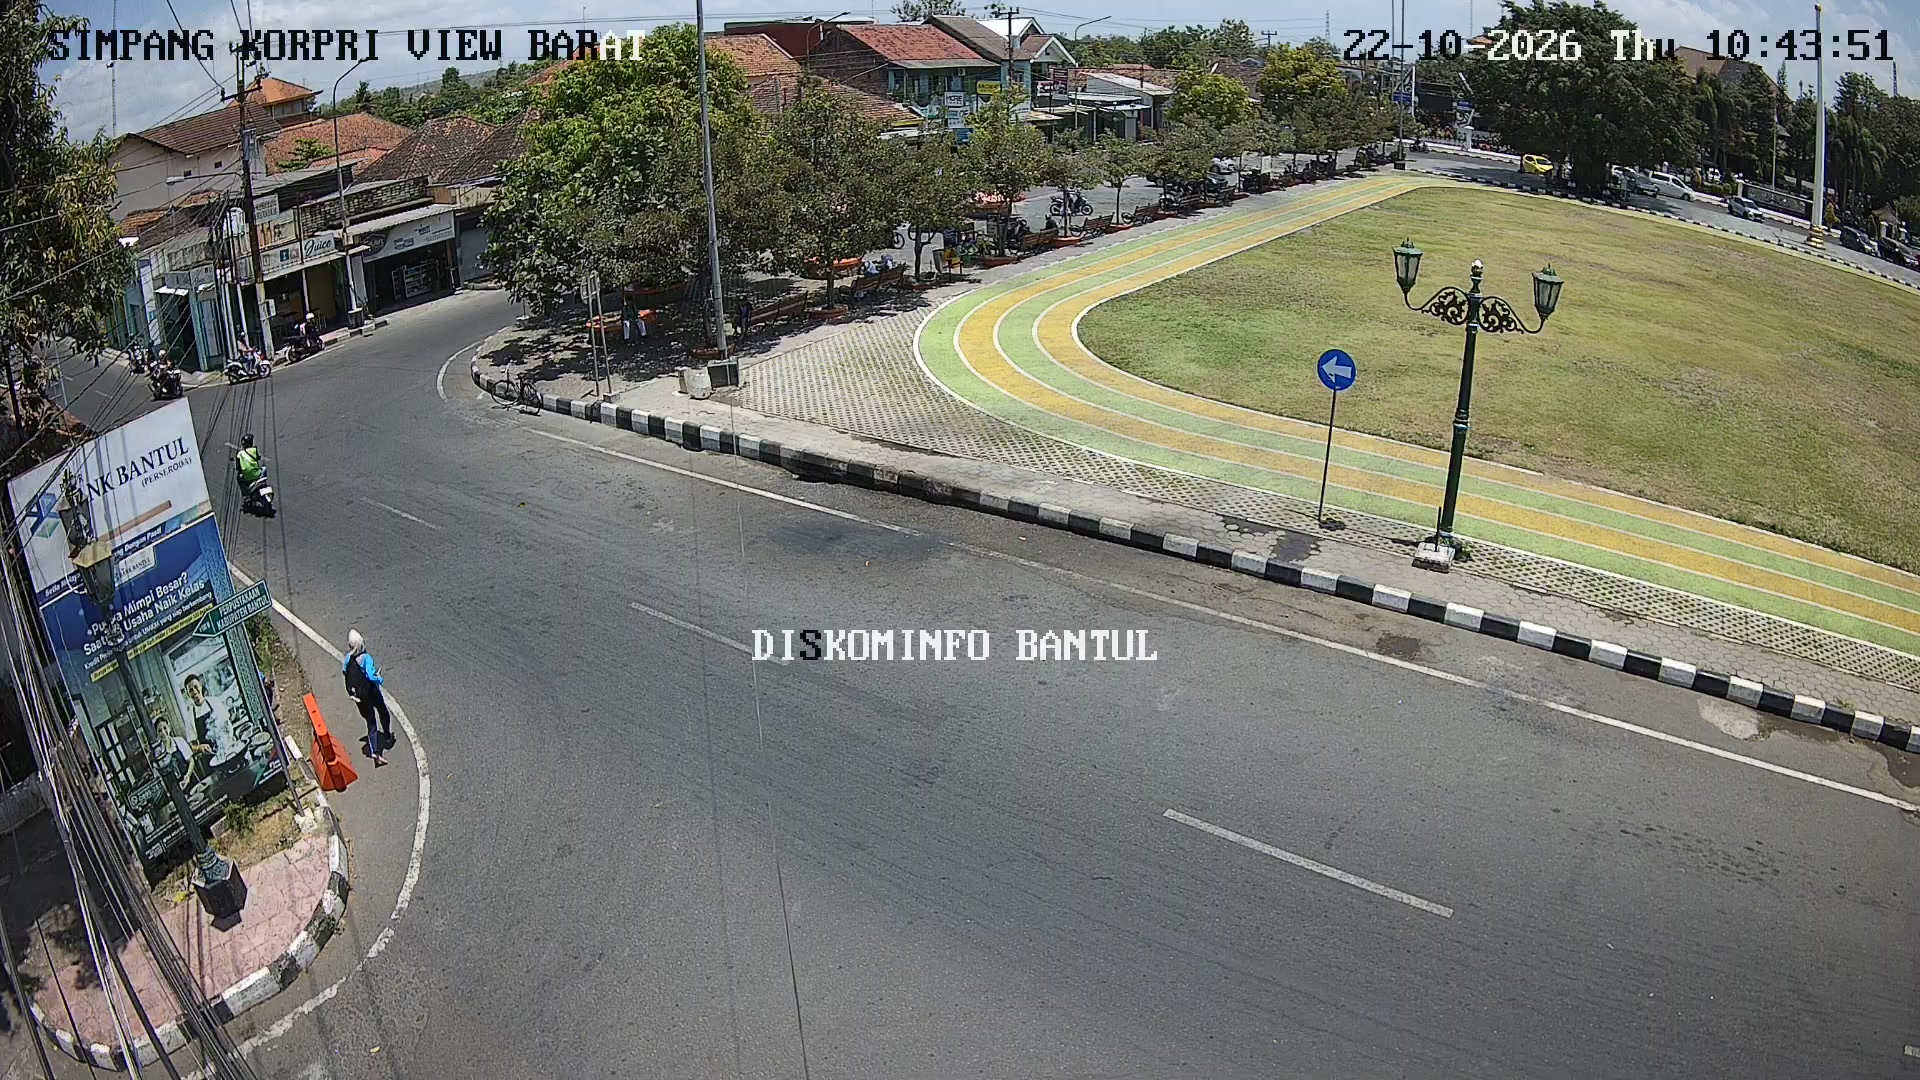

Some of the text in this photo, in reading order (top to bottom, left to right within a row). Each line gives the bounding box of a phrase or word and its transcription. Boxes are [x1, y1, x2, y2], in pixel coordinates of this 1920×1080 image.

[115, 436, 189, 487] BANTUL
[141, 457, 192, 488] (PERSERODA)
[123, 589, 155, 617] Mimpi
[155, 571, 189, 598] Besar?
[123, 608, 154, 632] Usaha
[154, 593, 178, 614] Naik
[178, 579, 206, 601] Kelas
[216, 608, 248, 631] KABUPATEN
[247, 595, 269, 612] BANTUL
[219, 586, 260, 617] PERPUSTAKAAN
